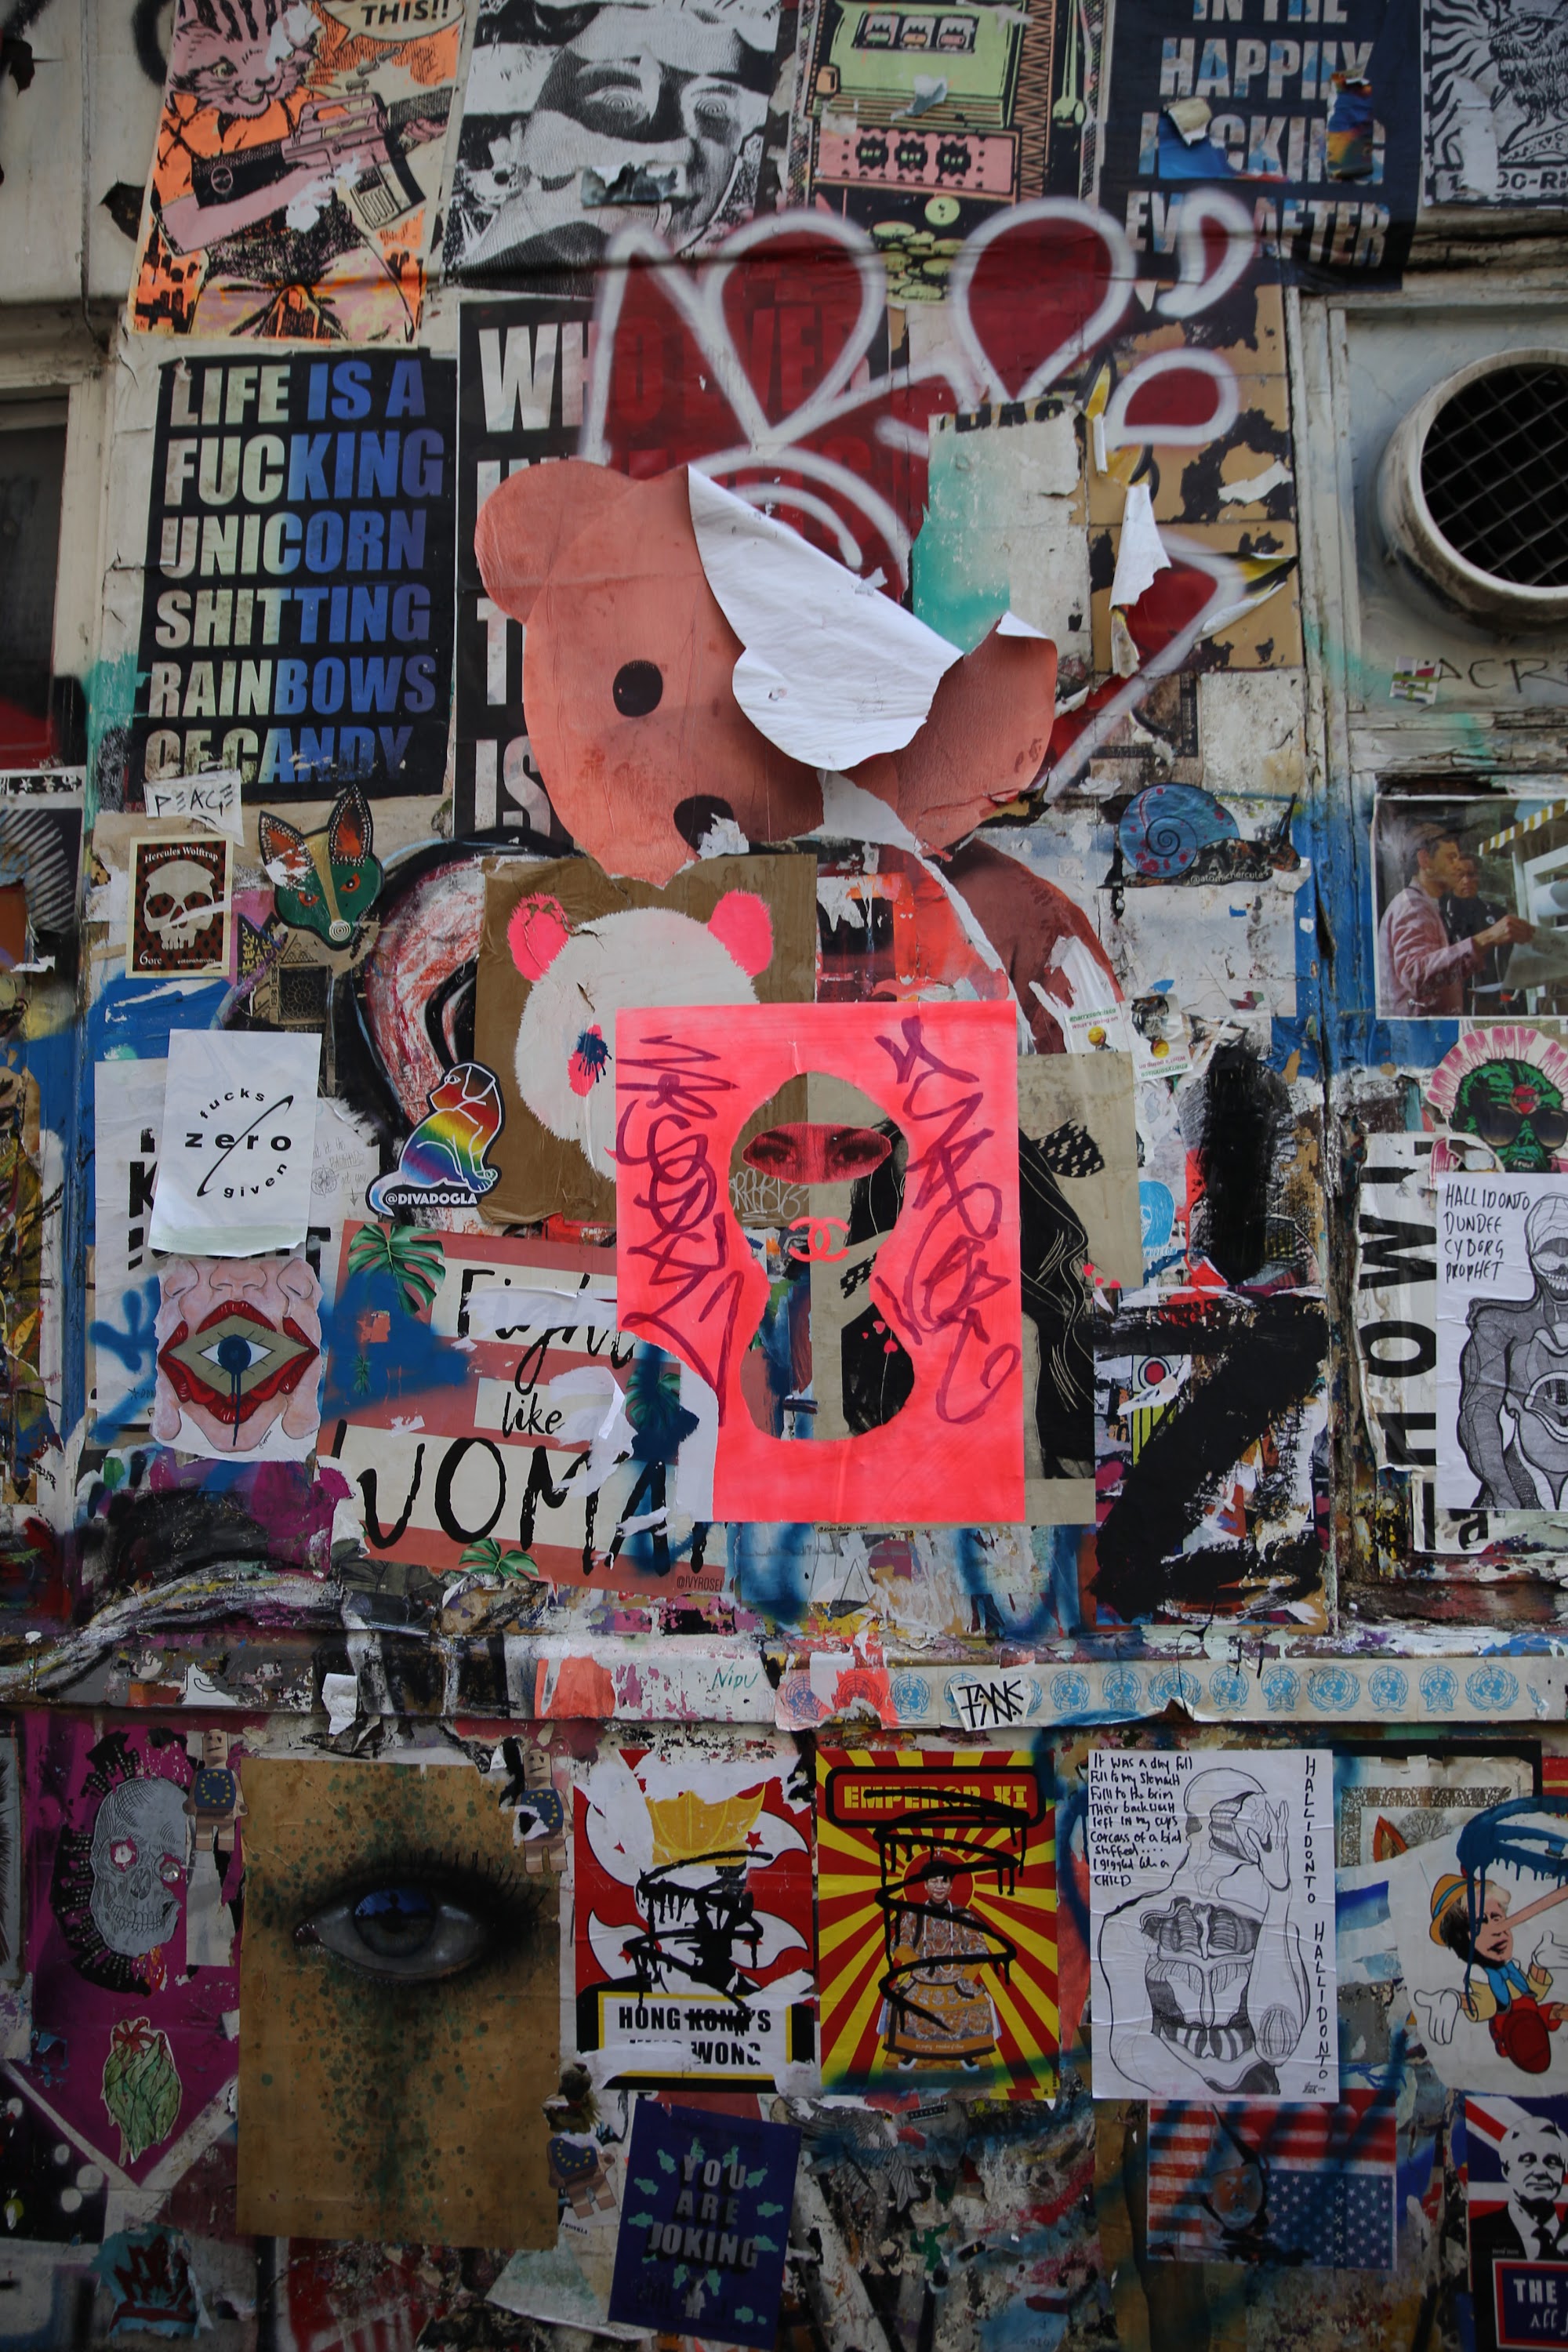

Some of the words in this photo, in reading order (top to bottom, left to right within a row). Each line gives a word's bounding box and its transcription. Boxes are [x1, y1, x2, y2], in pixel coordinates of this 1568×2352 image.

[170, 364, 290, 428] LIFE
[307, 360, 372, 422] IS
[386, 359, 426, 419] A
[163, 429, 445, 508] FUCKING
[159, 508, 426, 579] UNICORN
[154, 583, 431, 648] SHITTING
[148, 655, 437, 718] RAINBOWS
[221, 726, 414, 784] CANDY
[154, 784, 234, 817] PEACE
[144, 848, 181, 864] Hercules
[182, 846, 219, 862] Wolftrap
[200, 1087, 265, 1120] fucks
[185, 1132, 292, 1152] zero
[223, 1163, 287, 1198] given
[1446, 1183, 1530, 1210] HALLIDONTO
[386, 1192, 477, 1206] @DIVADOGLA
[1443, 1211, 1502, 1235] DUNDEE
[1444, 1238, 1504, 1261] CYBORG
[1446, 1260, 1504, 1283] PROPHET
[502, 1392, 563, 1438] like
[844, 1785, 981, 1809] EMPEROR
[993, 1786, 1028, 1809] XI
[1303, 1755, 1316, 1904] HALLIDONTO
[1314, 1921, 1331, 2079] HALLIDONTO
[619, 2006, 681, 2030] HONG
[683, 2154, 747, 2190] YOU
[676, 2189, 741, 2226] ARE
[648, 2222, 760, 2270] JOKING
[1512, 2278, 1558, 2305] THE
